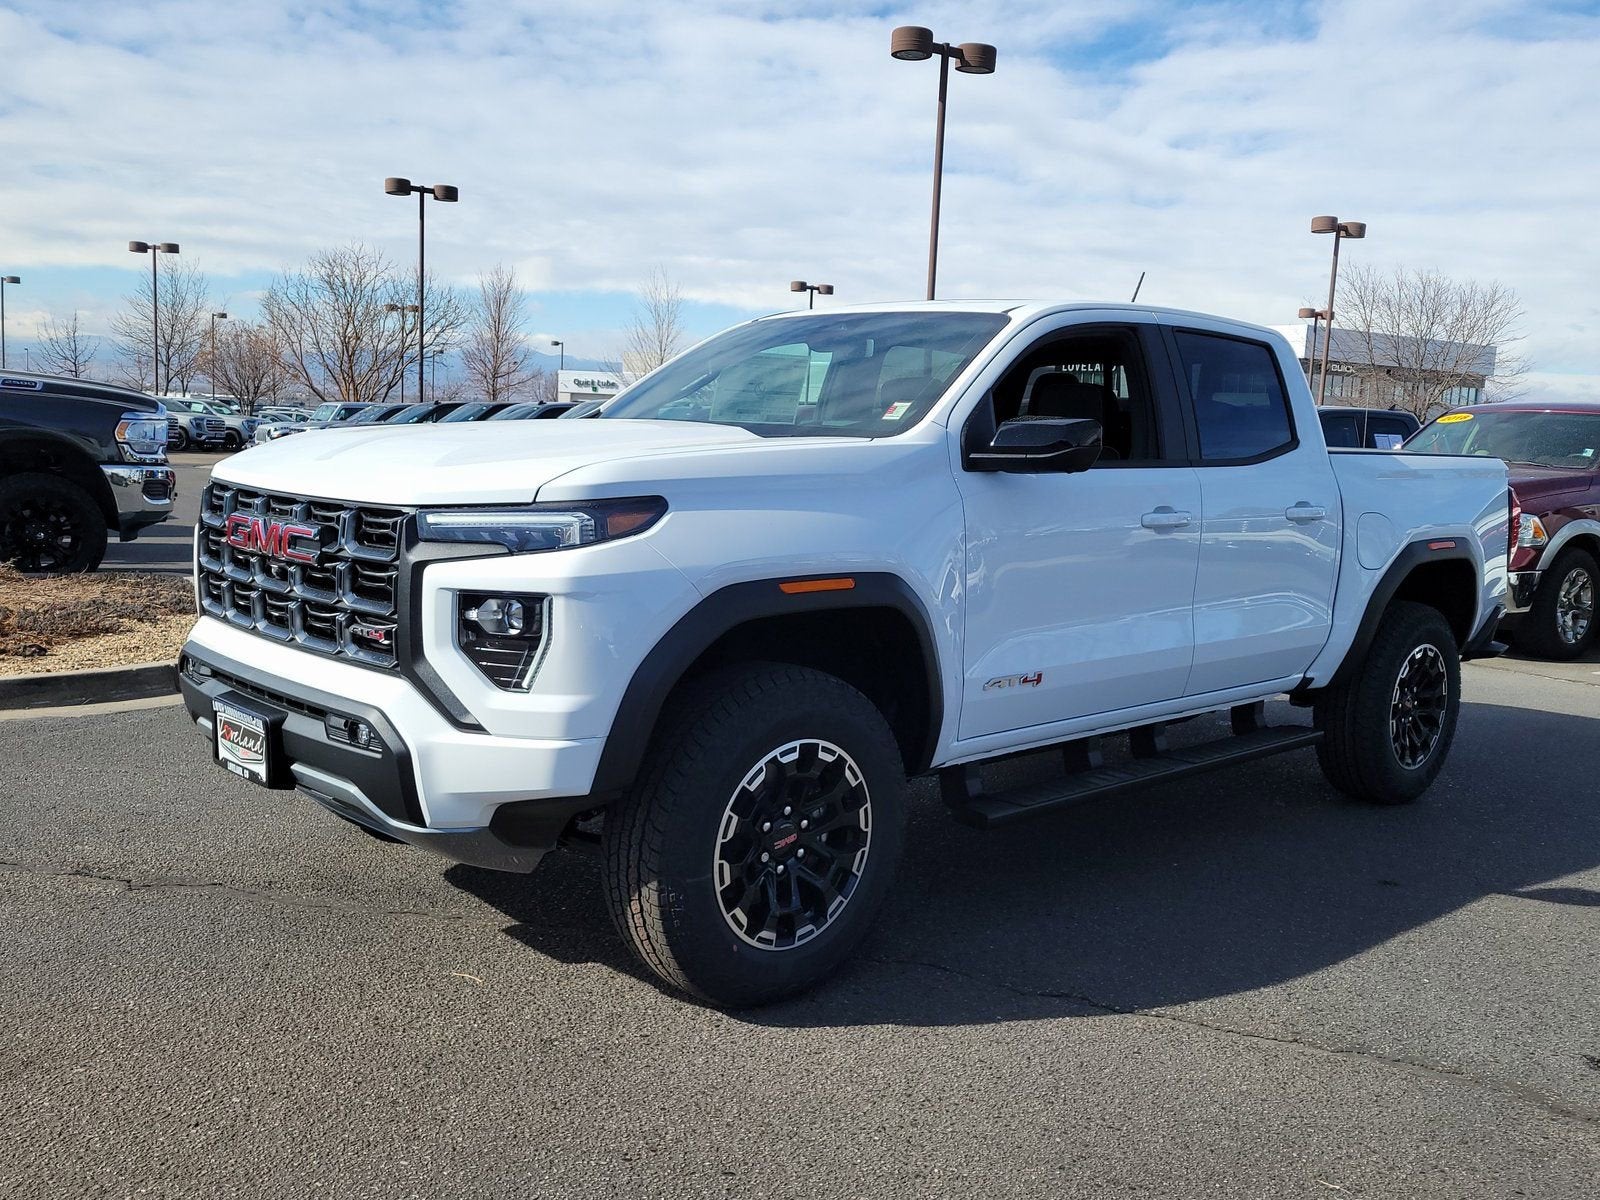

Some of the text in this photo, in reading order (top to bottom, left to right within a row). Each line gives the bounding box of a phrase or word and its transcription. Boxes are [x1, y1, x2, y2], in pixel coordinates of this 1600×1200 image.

[573, 378, 617, 388] Quick Lube
[225, 514, 320, 564] GMC
[349, 624, 386, 641] AT4
[983, 671, 1043, 691] AT4
[773, 833, 798, 850] GMC
